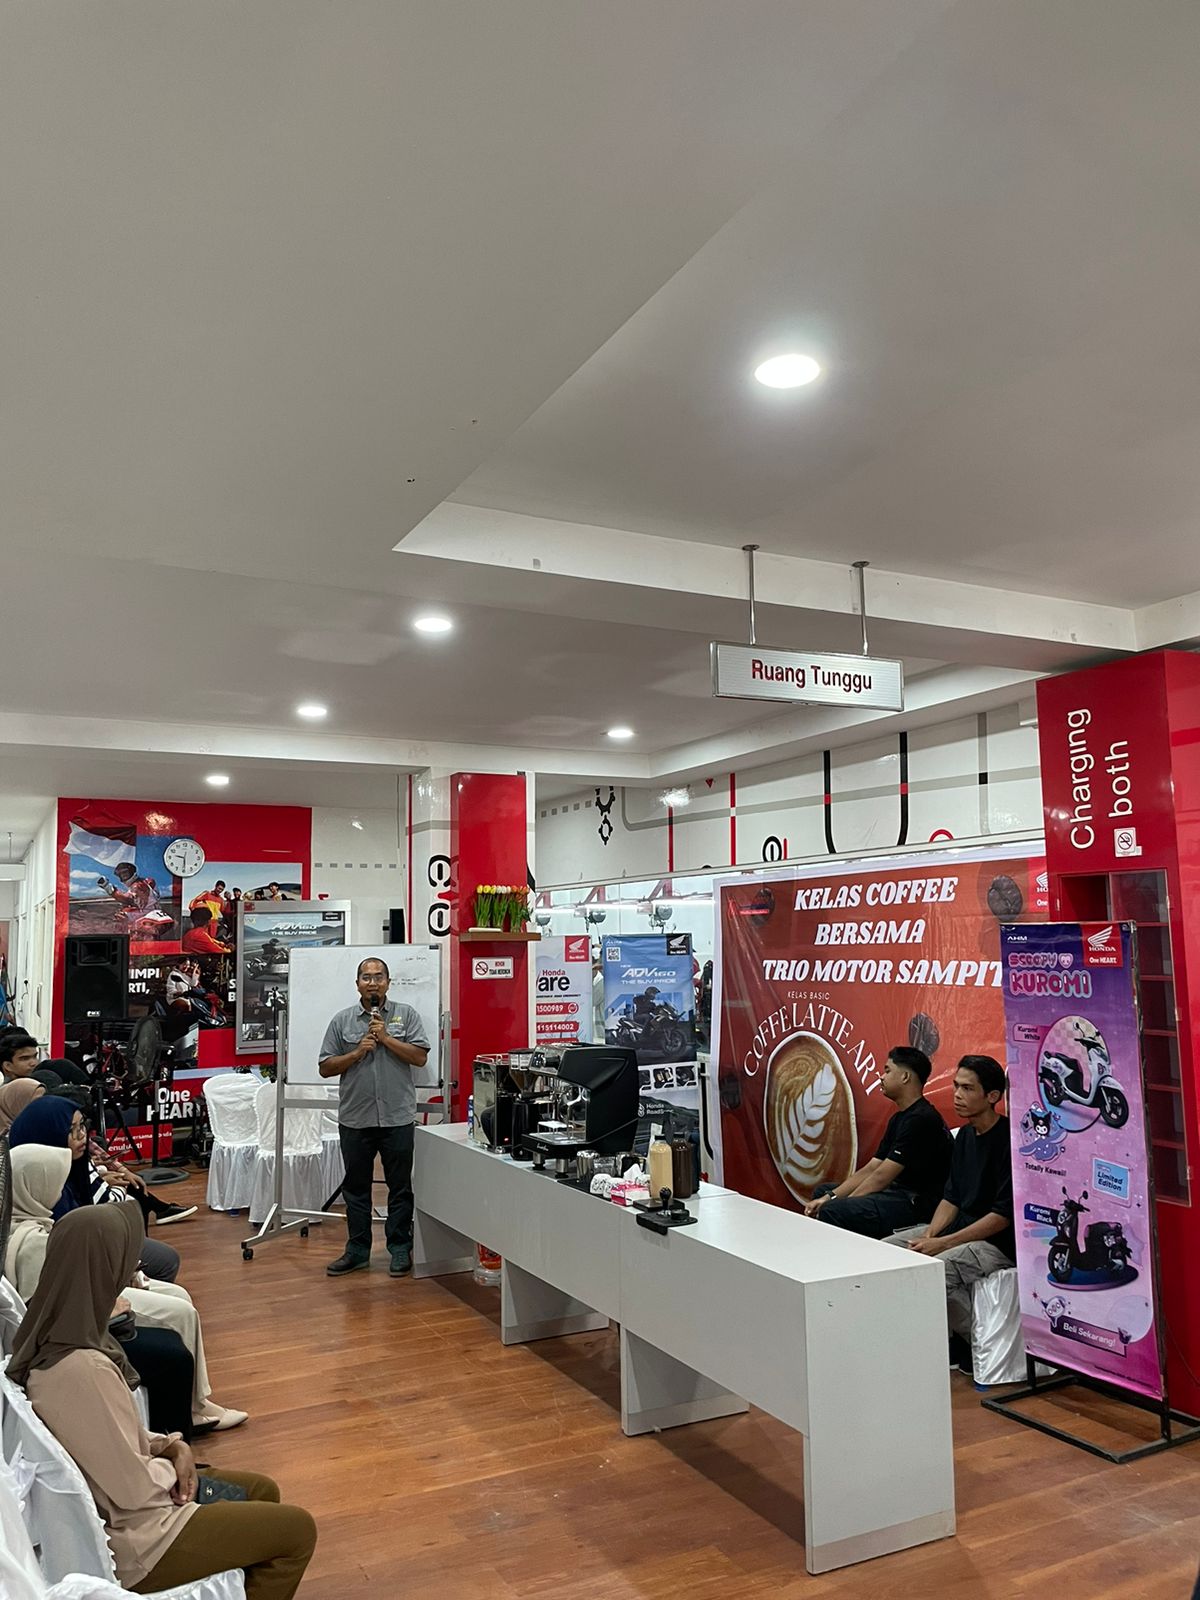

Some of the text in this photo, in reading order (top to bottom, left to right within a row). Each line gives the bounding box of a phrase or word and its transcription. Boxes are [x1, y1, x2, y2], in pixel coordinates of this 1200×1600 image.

[752, 659, 872, 693] Ruang Tunggu
[1067, 708, 1095, 849] Charging
[1104, 740, 1133, 817] both
[794, 877, 959, 911] KELAS COFFEE
[814, 919, 926, 946] BERSAMA
[1008, 952, 1058, 968] SCOOPY
[621, 967, 677, 978] ADV160
[762, 959, 1003, 987] TRIO MOTOR SAMPIT
[536, 975, 570, 992] are
[1009, 969, 1093, 998] KUROMI
[787, 991, 830, 1000] KELAS BASIC
[1017, 1026, 1038, 1034] Kuromi
[743, 1002, 884, 1096] COFFE LATTE ART
[158, 1087, 190, 1103] One
[146, 1102, 201, 1121] HEAR
[1025, 1162, 1067, 1177] Totally Kawaii!
[1097, 1171, 1123, 1185] Limited
[1098, 1179, 1122, 1192] Edition
[1029, 1205, 1051, 1216] Kuromi
[1036, 1213, 1053, 1224] Black
[1063, 1322, 1116, 1348] Beli Sekarang!
